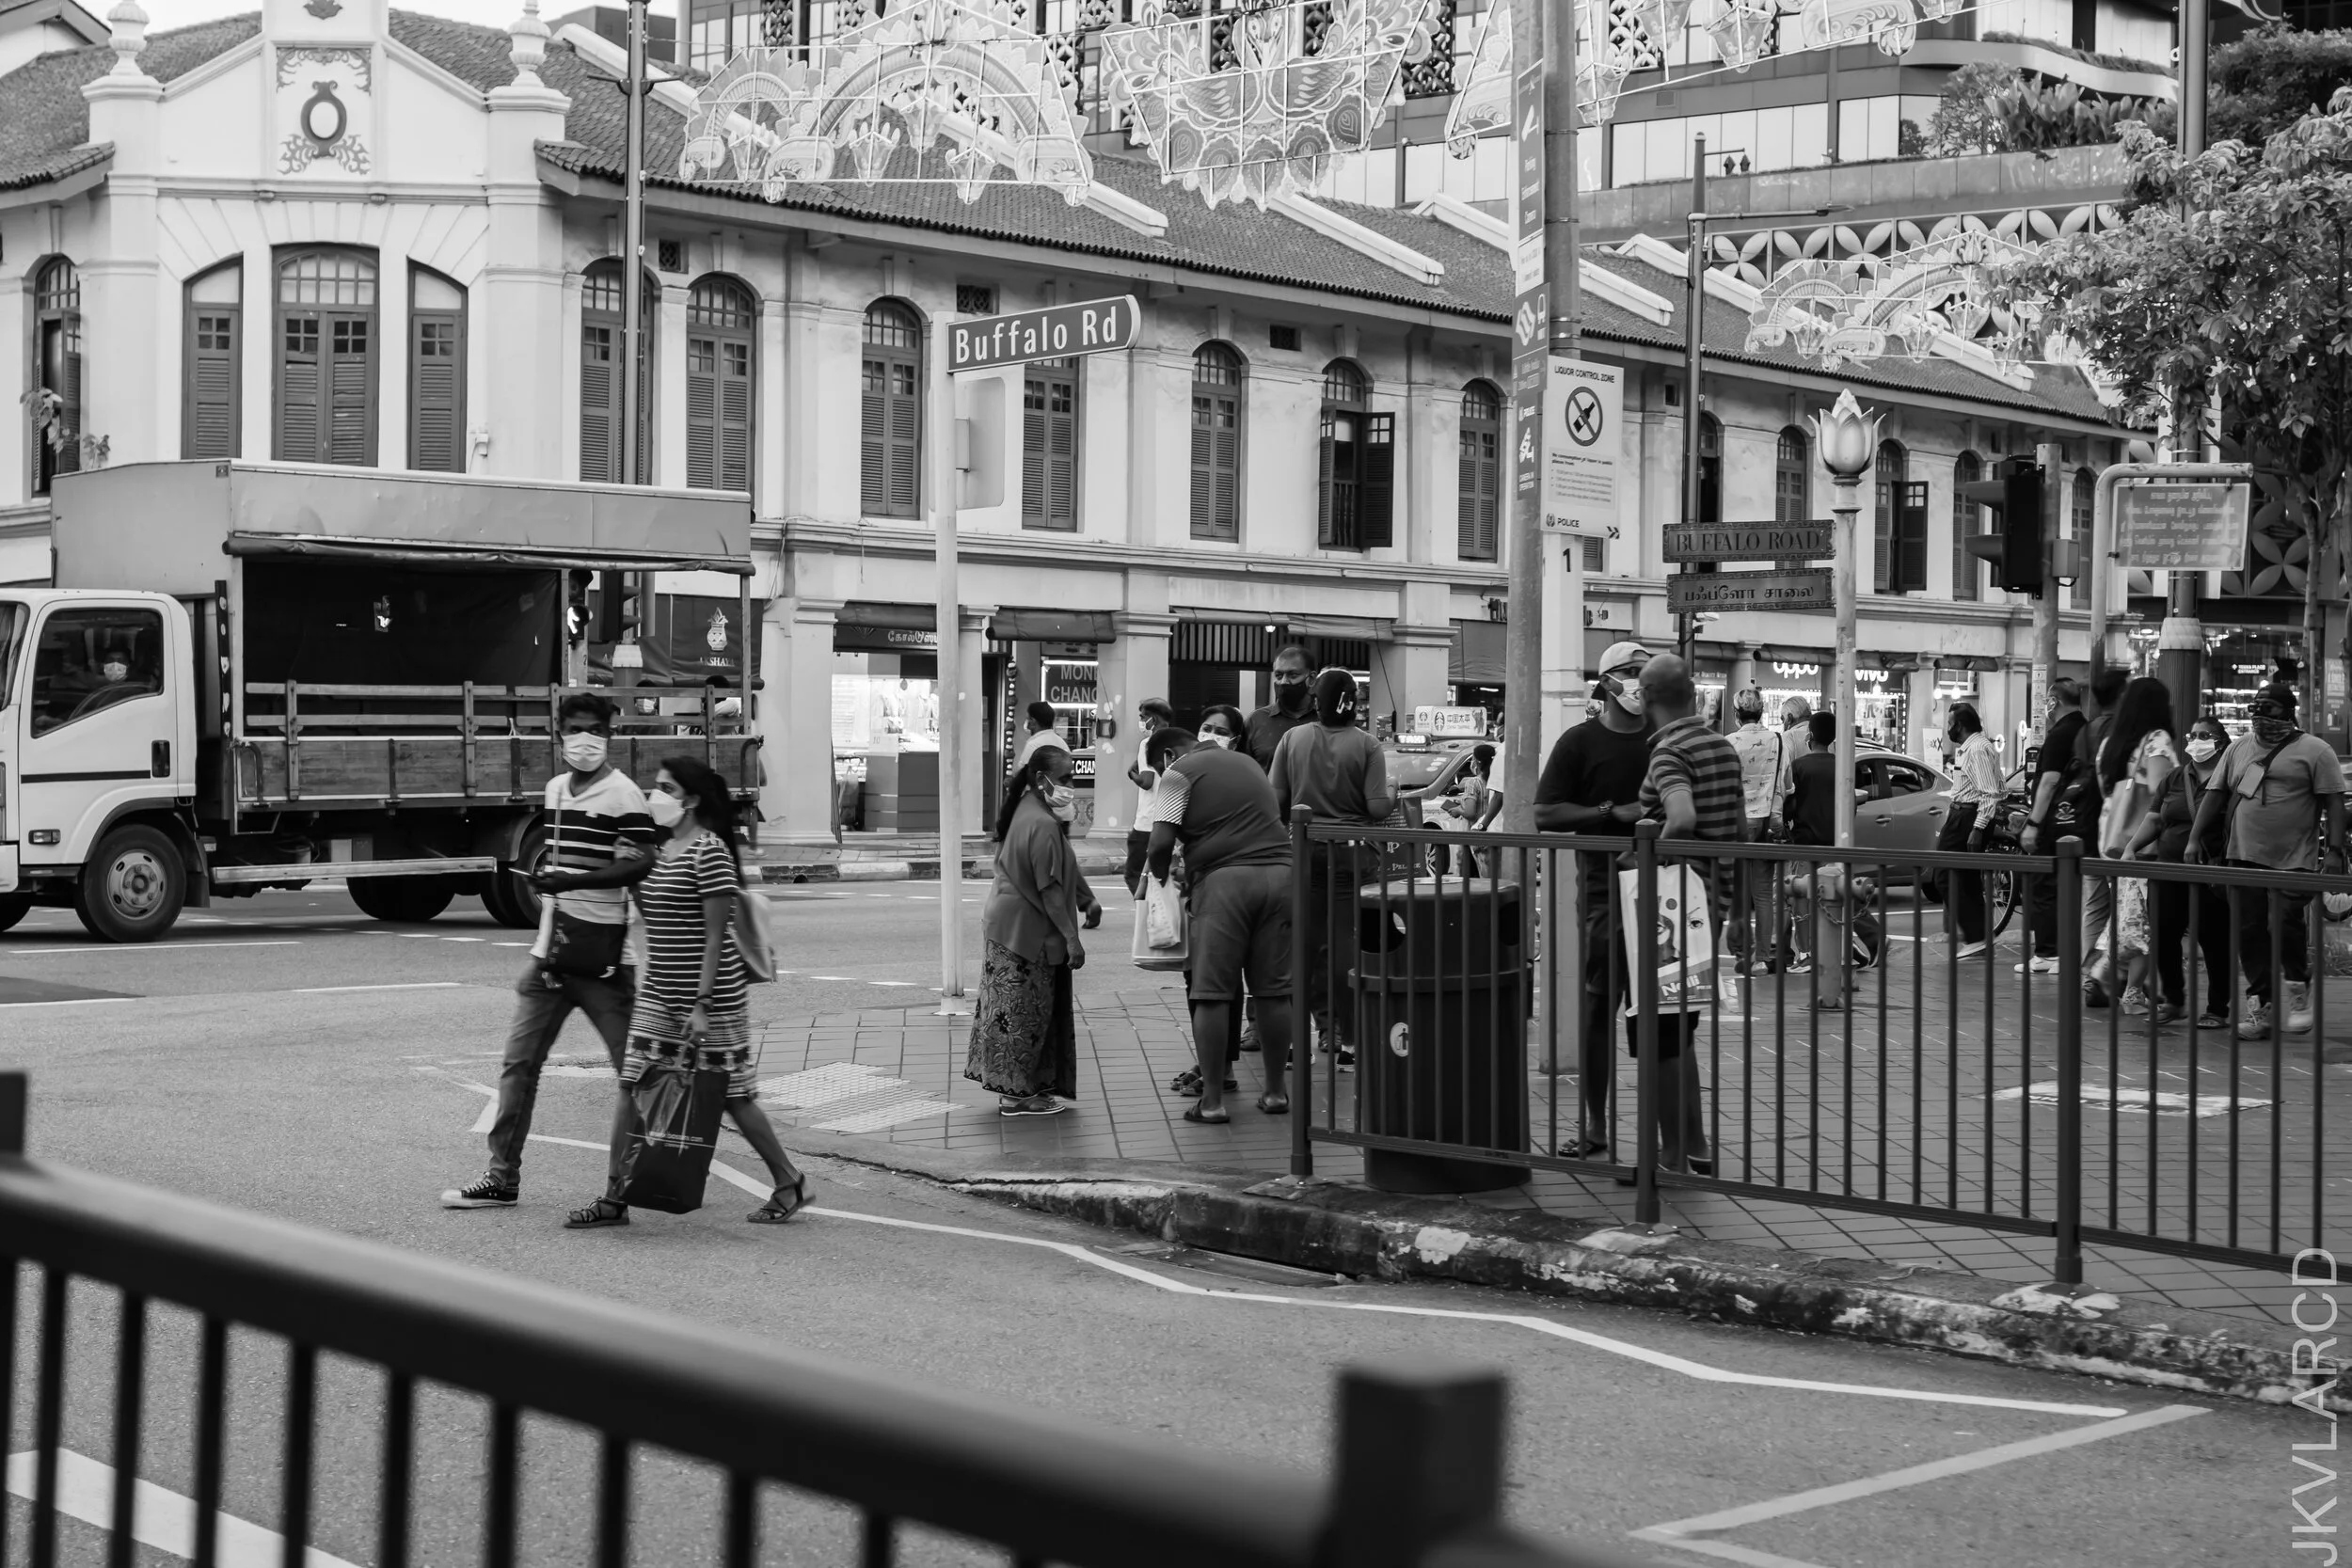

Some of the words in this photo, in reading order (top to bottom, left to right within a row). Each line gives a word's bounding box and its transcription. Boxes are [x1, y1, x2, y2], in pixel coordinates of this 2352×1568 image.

[956, 316, 1068, 364] Buffalo
[1082, 306, 1117, 345] Rd
[1554, 365, 1575, 376] LIQUOR
[1576, 369, 1600, 381] CONTROL
[1600, 372, 1615, 384] ZONE
[1557, 517, 1581, 529] POLICE
[1677, 531, 1760, 552] BUFFALO
[1769, 531, 1820, 551] ROAD
[1563, 547, 1571, 573] 1
[1764, 586, 1814, 599] சாலை
[1854, 669, 1889, 683] vivo
